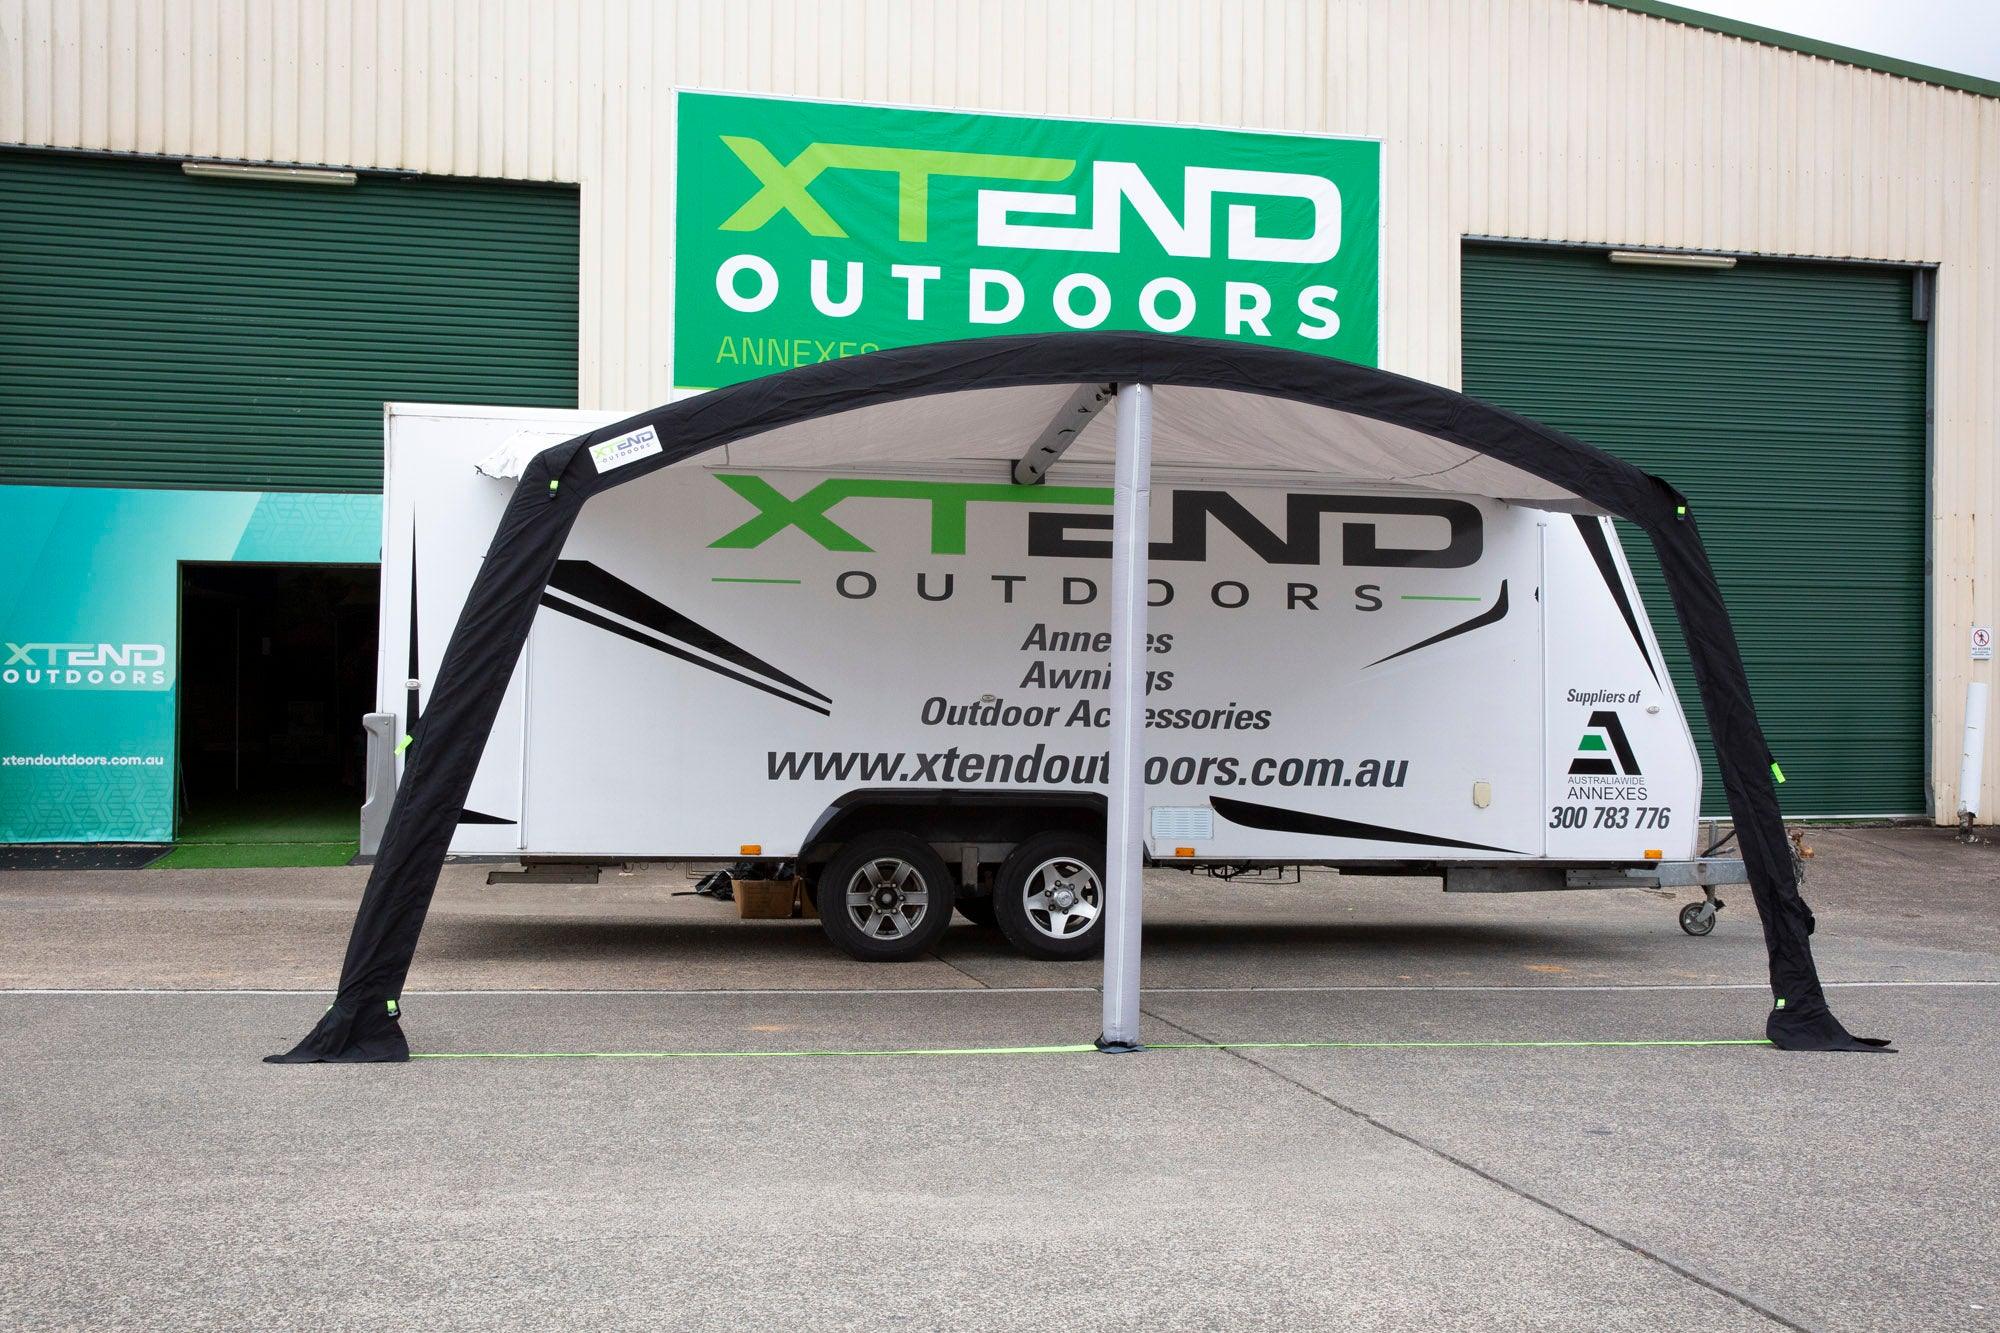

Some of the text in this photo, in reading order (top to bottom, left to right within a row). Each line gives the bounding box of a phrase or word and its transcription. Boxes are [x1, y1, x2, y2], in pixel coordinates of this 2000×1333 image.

[718, 135, 1343, 264] XTEND
[715, 254, 1341, 340] OUTDOORS
[602, 443, 650, 463] OUTDOORS
[4, 643, 165, 667] XTEND
[2, 669, 165, 684] OUTDOORS
[1567, 688, 1641, 706] Suppliers of
[920, 696, 1060, 727] Outdoor
[2, 754, 164, 766] xtendoutdoors.com.au
[767, 743, 1409, 788] www.xtendoutoors.com.au
[1567, 776, 1645, 785] AUSTRALIAWIDE
[1567, 787, 1648, 800] ANNEXES
[1549, 806, 1671, 829] 300 783 776
